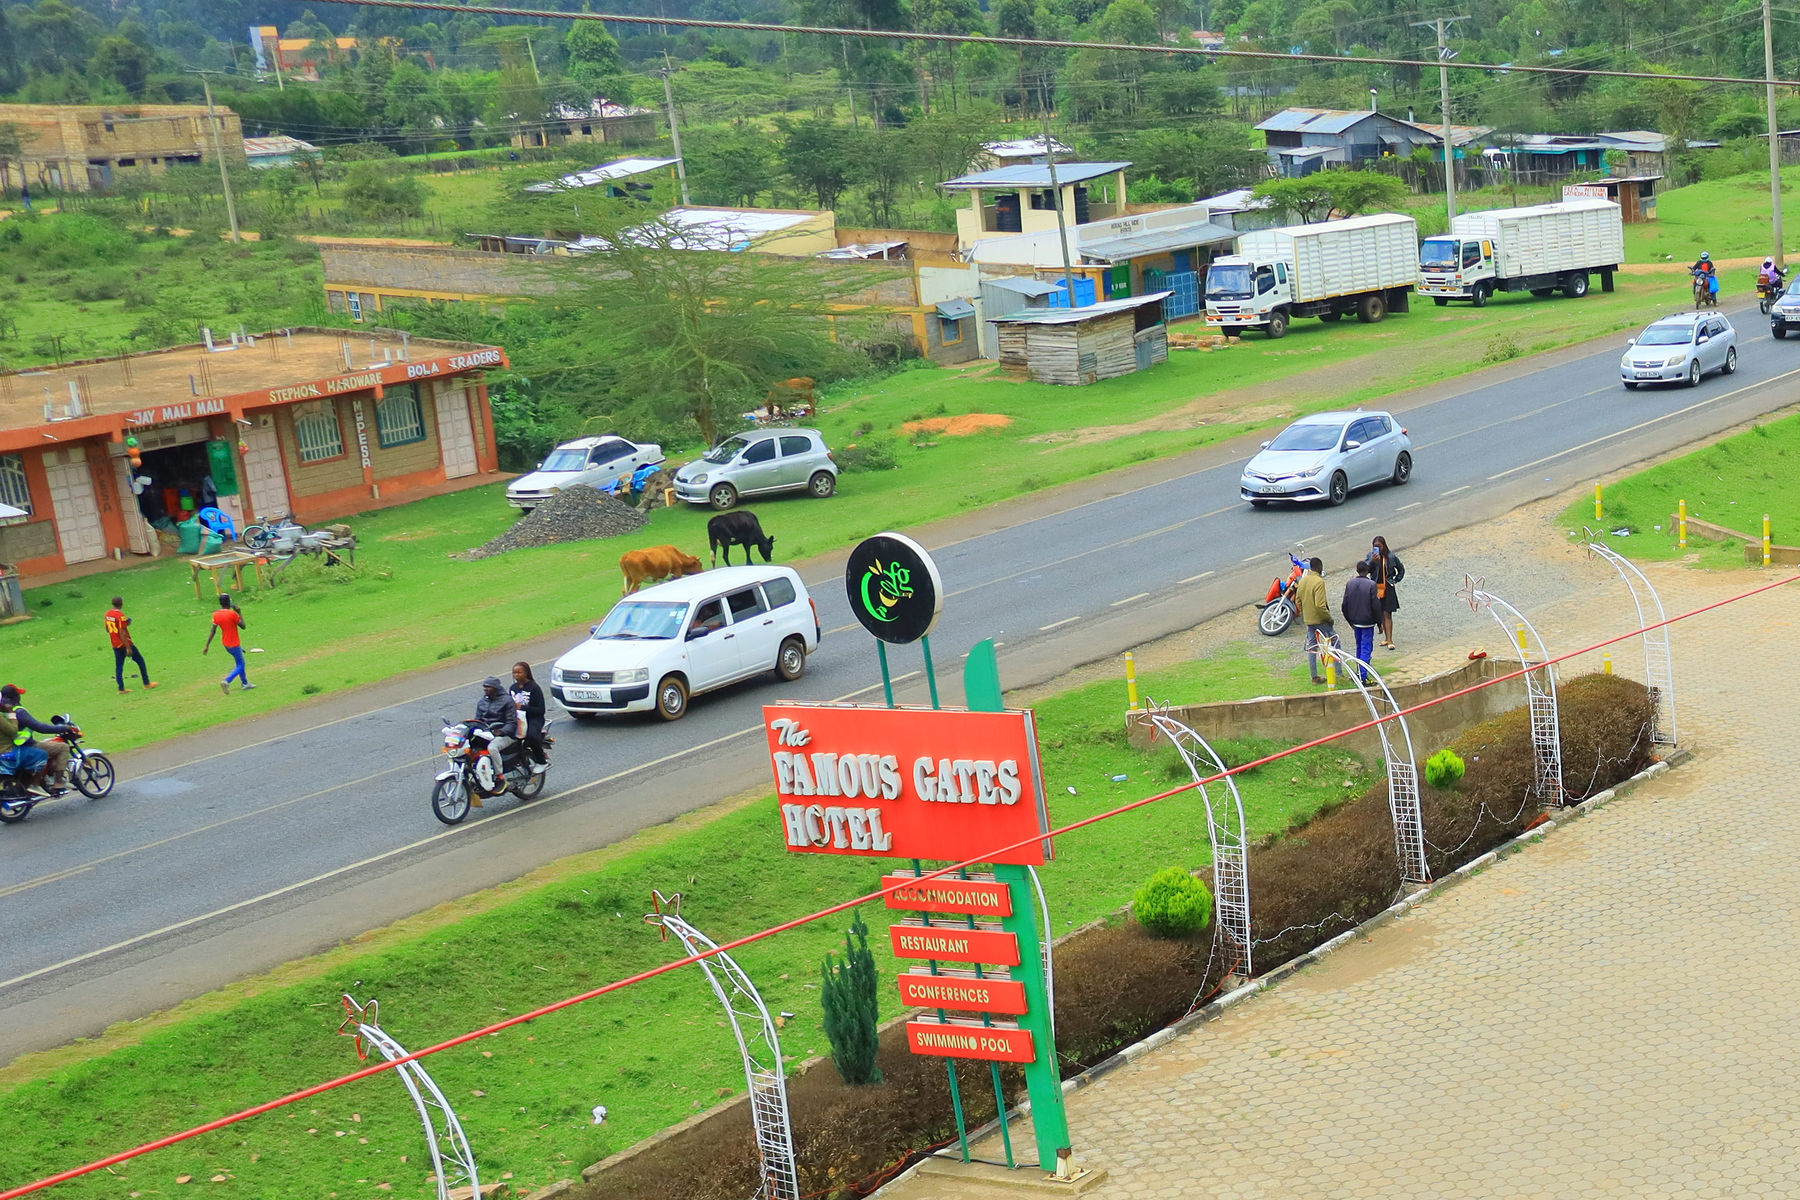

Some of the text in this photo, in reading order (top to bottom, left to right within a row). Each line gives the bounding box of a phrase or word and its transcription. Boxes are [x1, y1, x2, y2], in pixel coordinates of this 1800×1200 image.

[407, 350, 500, 378] BOLA TRADERS
[269, 372, 383, 403] STEPHON HARDWARE
[133, 409, 155, 425] JAY
[162, 404, 192, 420] MALI
[196, 399, 225, 416] MALI
[771, 718, 812, 747] The
[773, 751, 1022, 806] FAMOUS GATES
[782, 803, 893, 852] HOTEL
[892, 887, 999, 908] ACCOMMODATION
[900, 935, 969, 954] RESTAURANT
[908, 984, 989, 1003] CONFERENCES
[980, 1037, 1012, 1053] POOL
